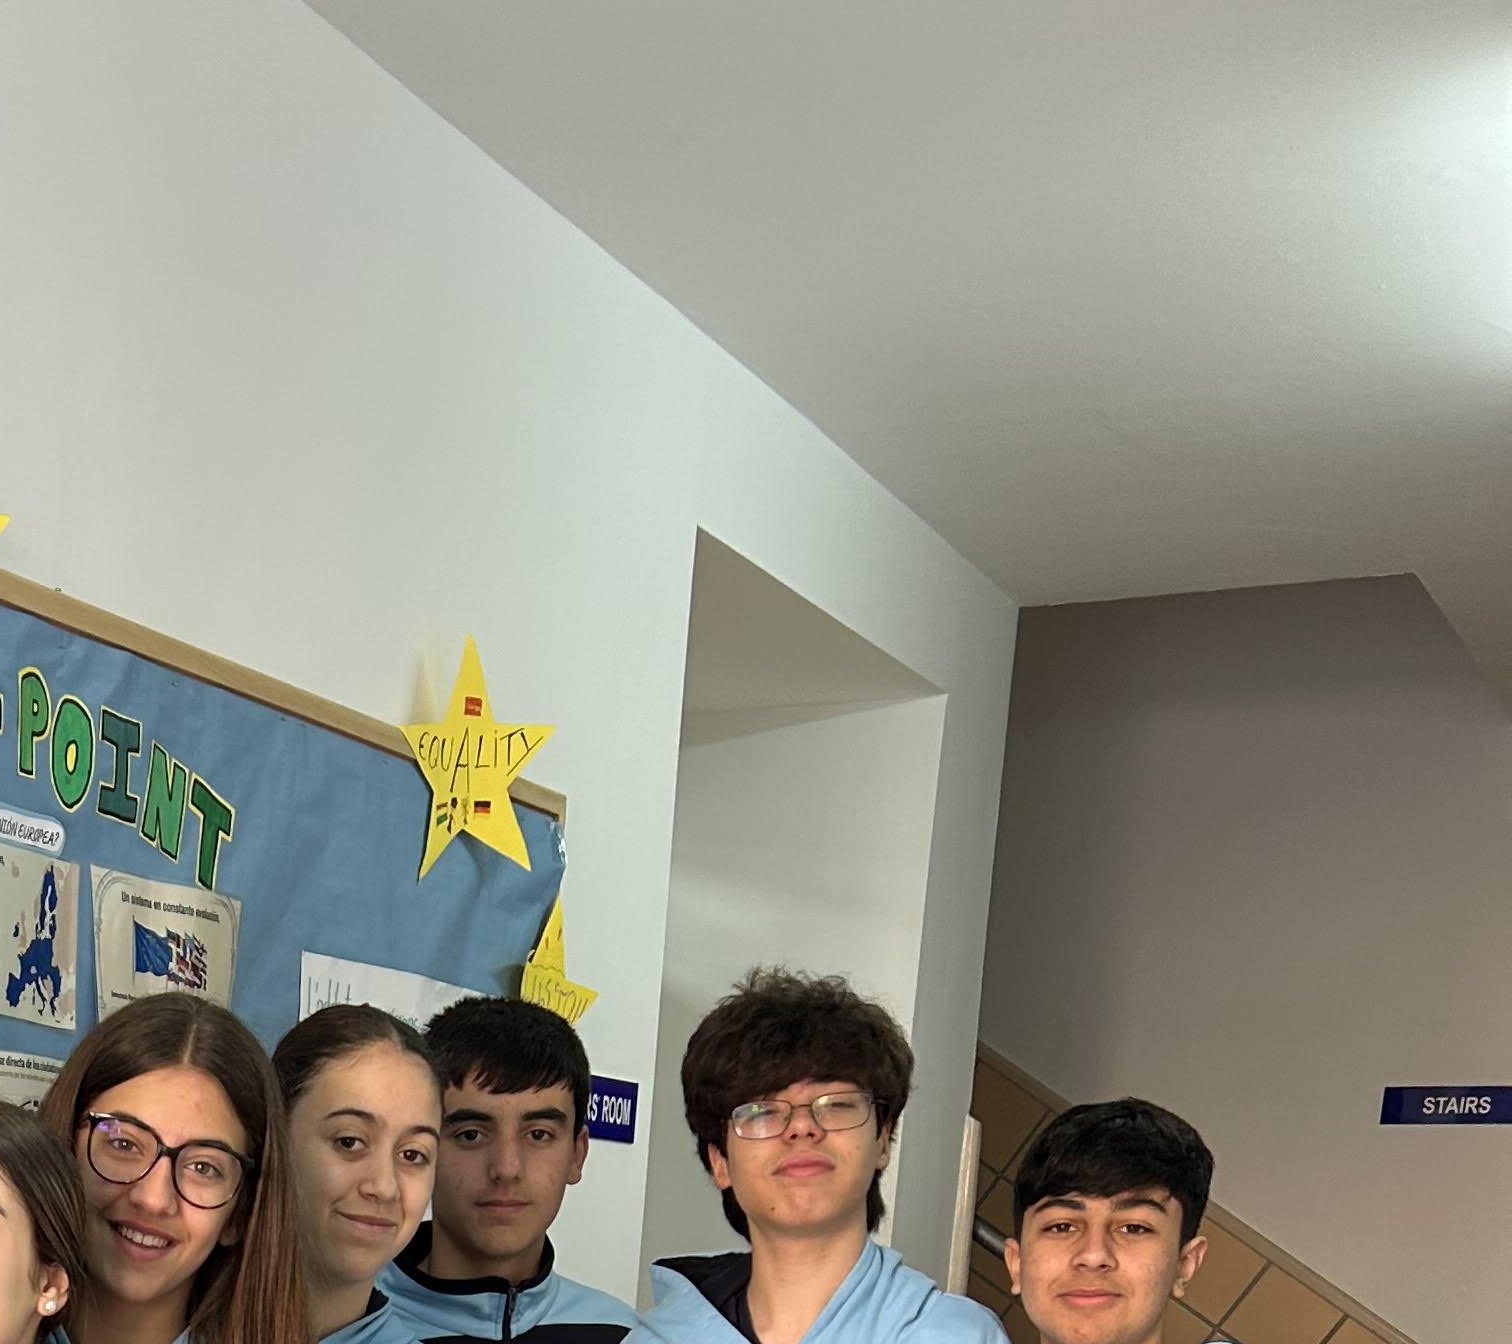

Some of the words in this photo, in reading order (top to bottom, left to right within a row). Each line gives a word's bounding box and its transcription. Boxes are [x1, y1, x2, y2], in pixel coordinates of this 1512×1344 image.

[418, 726, 544, 793] EQUALITY
[18, 823, 59, 846] EUROPEA?
[601, 1095, 632, 1126] ROOM
[1422, 1096, 1492, 1115] STAIRS
